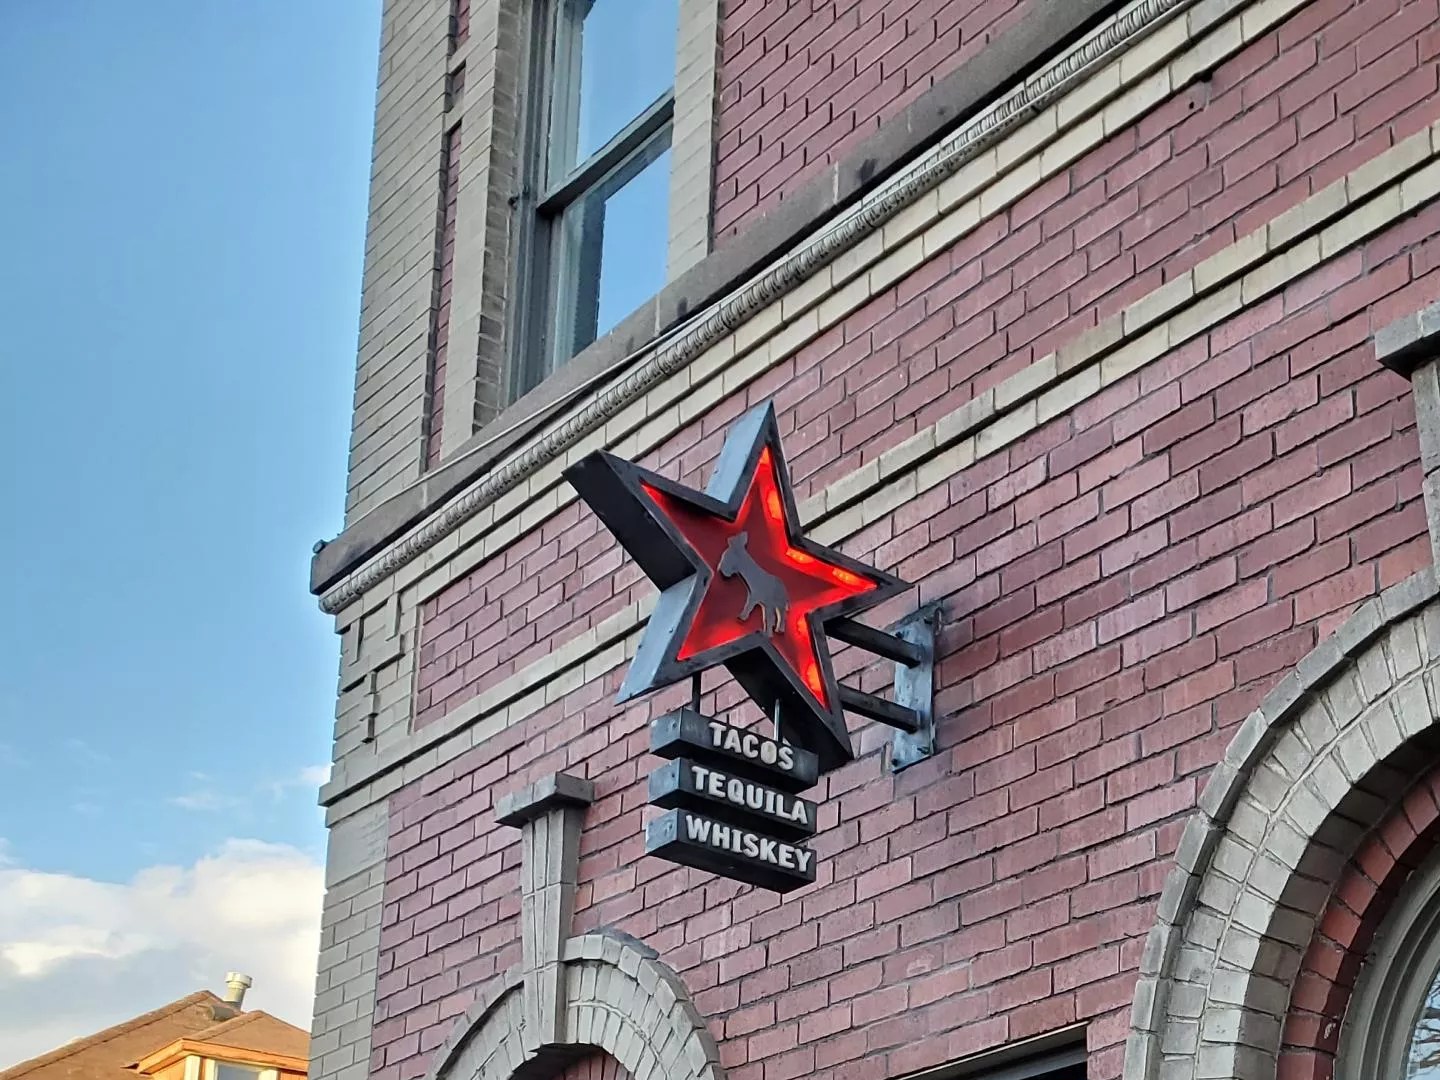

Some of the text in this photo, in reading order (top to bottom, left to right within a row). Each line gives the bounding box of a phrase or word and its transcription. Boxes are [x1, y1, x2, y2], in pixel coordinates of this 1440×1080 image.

[708, 721, 794, 771] TACOS
[691, 765, 808, 825] TEQUILA
[685, 815, 812, 872] WHISKEY
